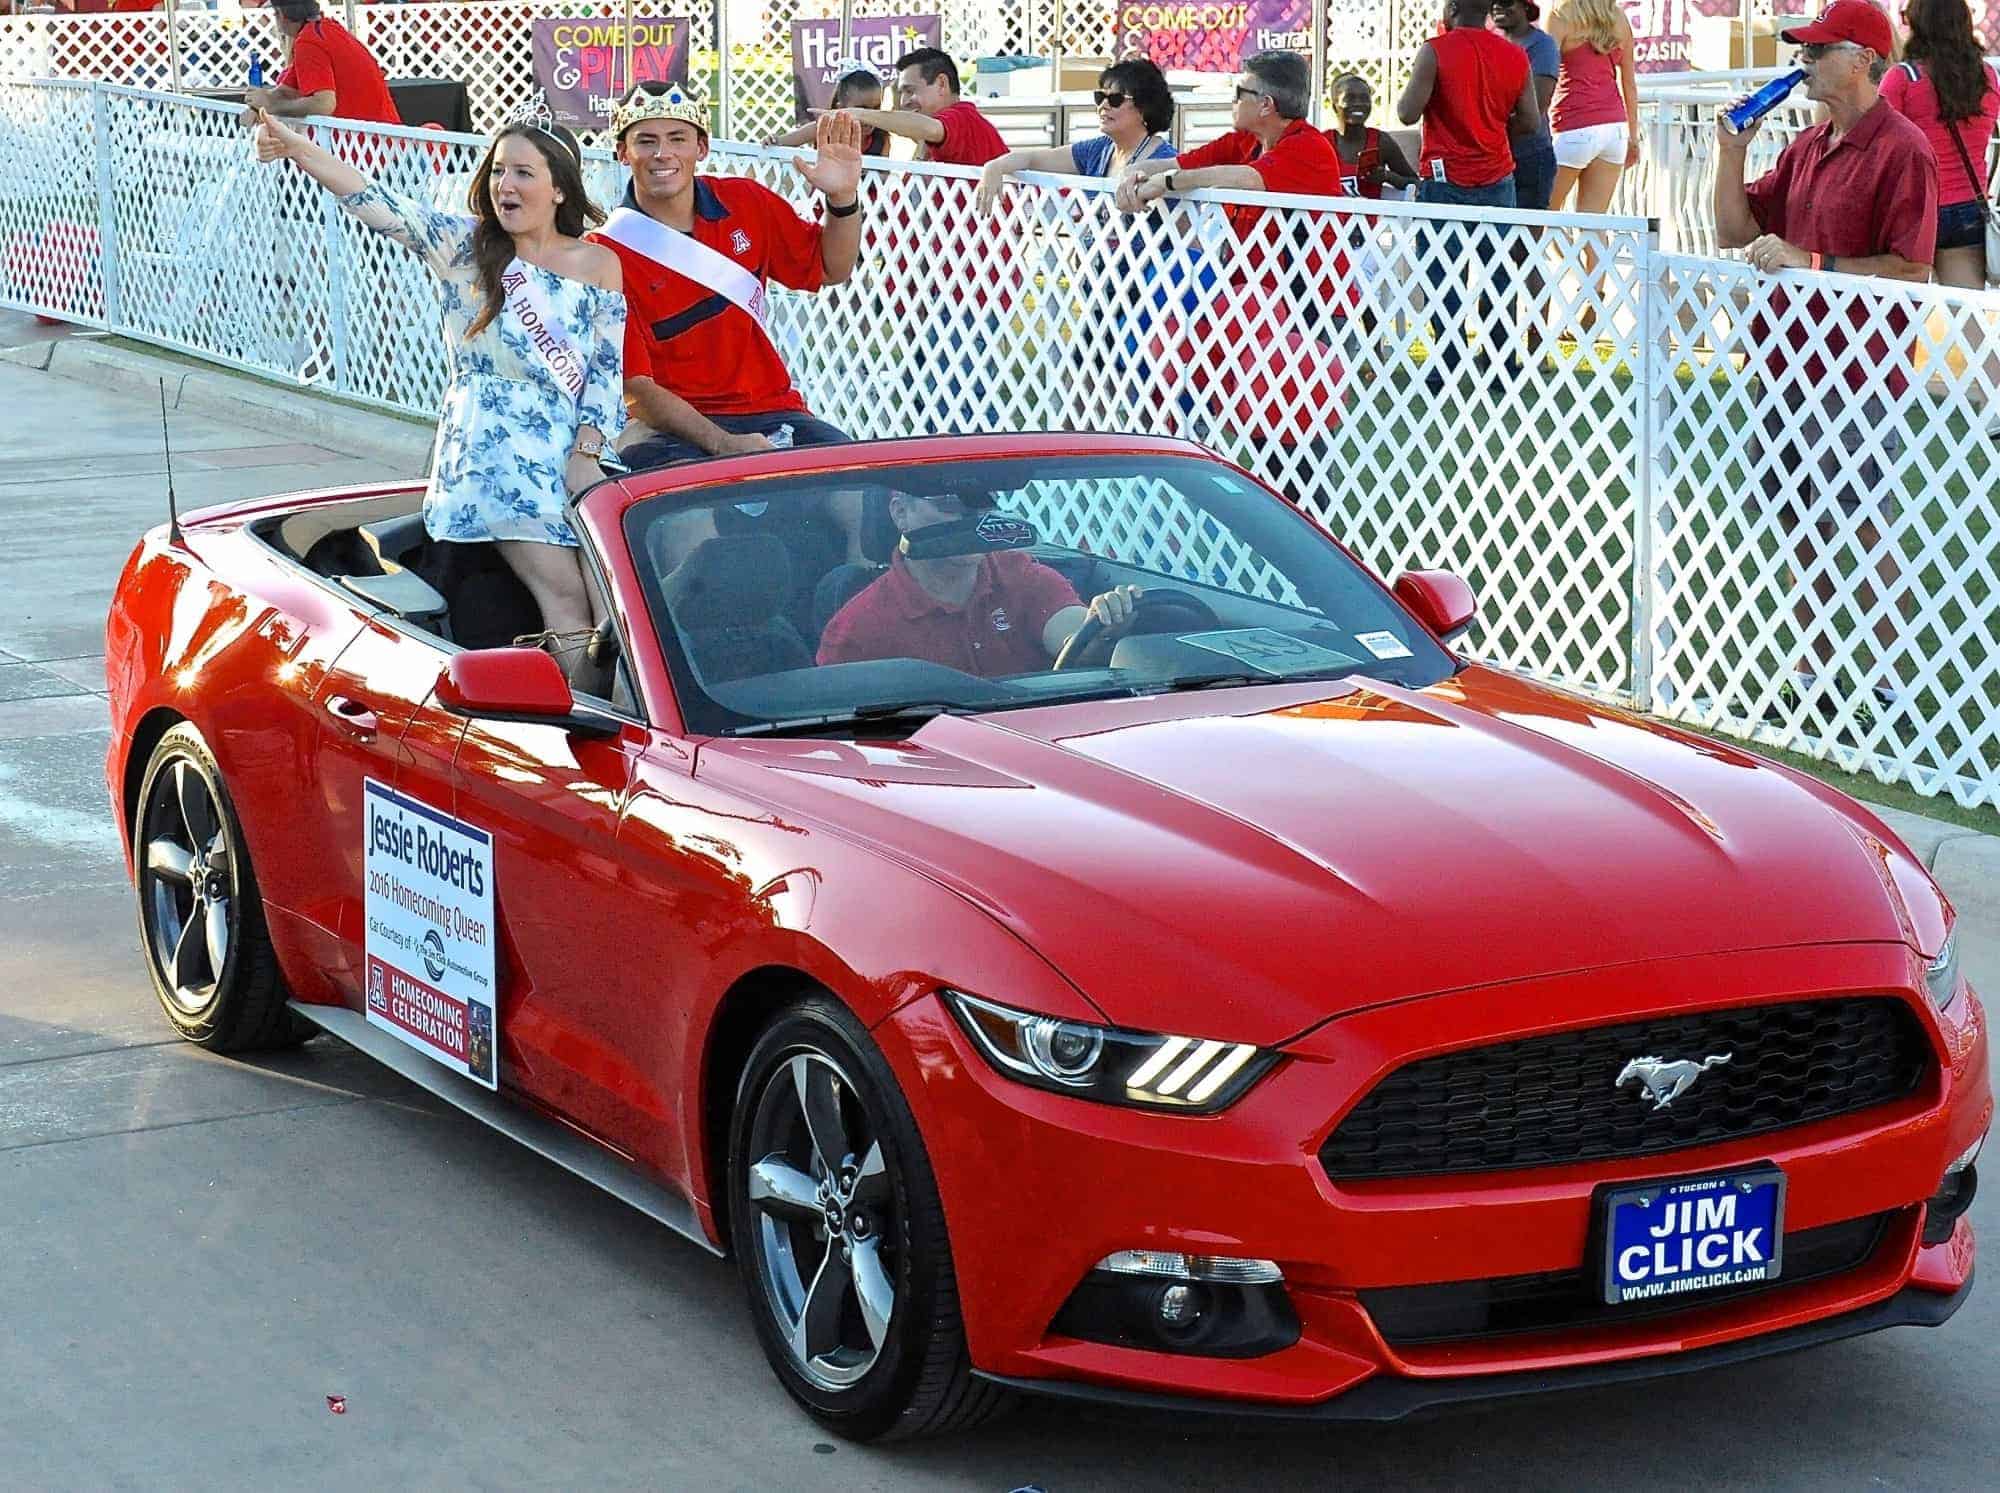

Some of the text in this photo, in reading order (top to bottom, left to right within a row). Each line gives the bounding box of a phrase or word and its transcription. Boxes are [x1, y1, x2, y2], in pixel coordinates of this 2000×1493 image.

[1149, 28, 1246, 73] PLAY
[1633, 40, 1692, 61] CASIN
[369, 802, 483, 897] Jessie Roberts
[369, 916, 379, 933] Car
[370, 870, 486, 947] 2016 Homecoming Queen
[391, 974, 463, 1030] HOMECOMING
[392, 997, 463, 1053] CELEBRATION
[1679, 1181, 1717, 1194] TUCSON
[1649, 1194, 1737, 1237] JIM
[1618, 1227, 1763, 1281] CLICK
[1621, 1267, 1766, 1301] WWW.JIMCLICK.COM
